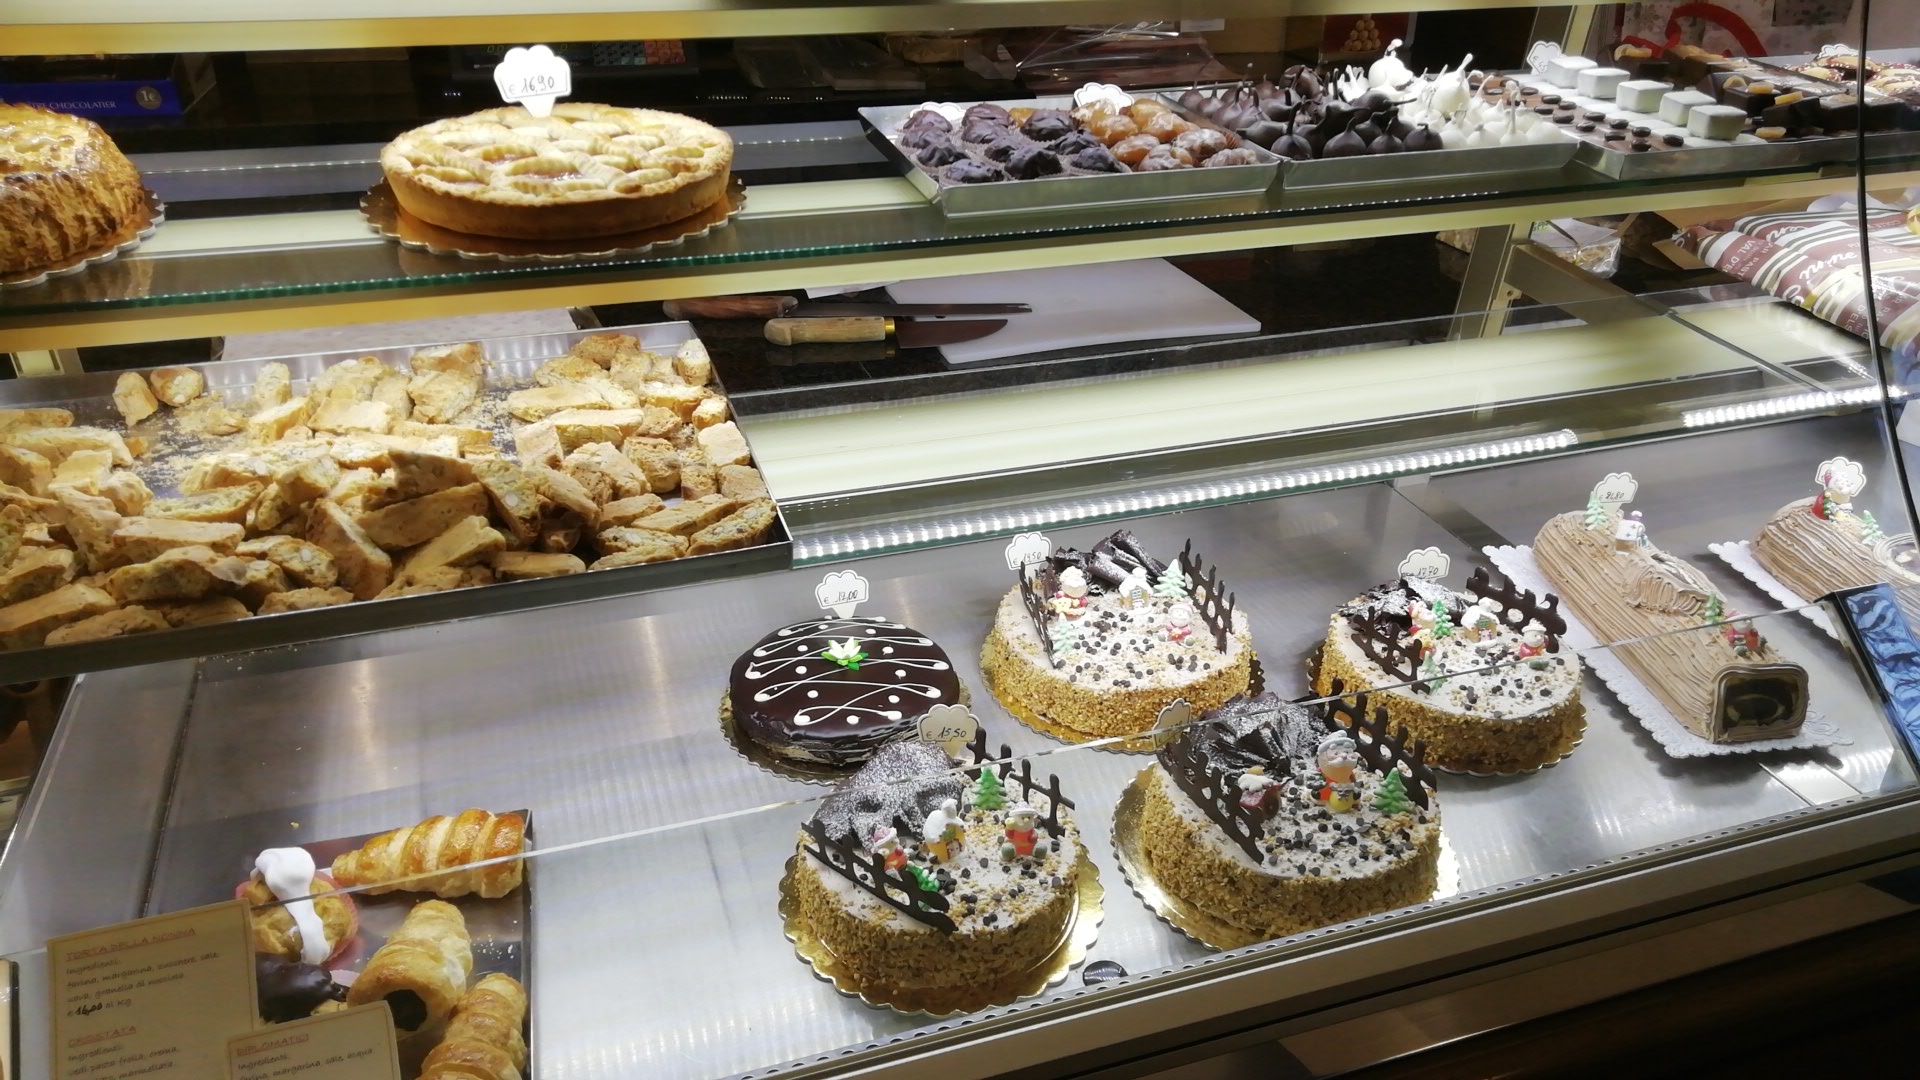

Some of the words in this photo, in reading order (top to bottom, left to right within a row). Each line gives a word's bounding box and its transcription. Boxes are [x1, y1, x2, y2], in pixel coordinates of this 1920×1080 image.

[521, 75, 555, 95] 16,90
[50, 100, 117, 110] CHOCOLATIER
[938, 726, 967, 742] 15,50
